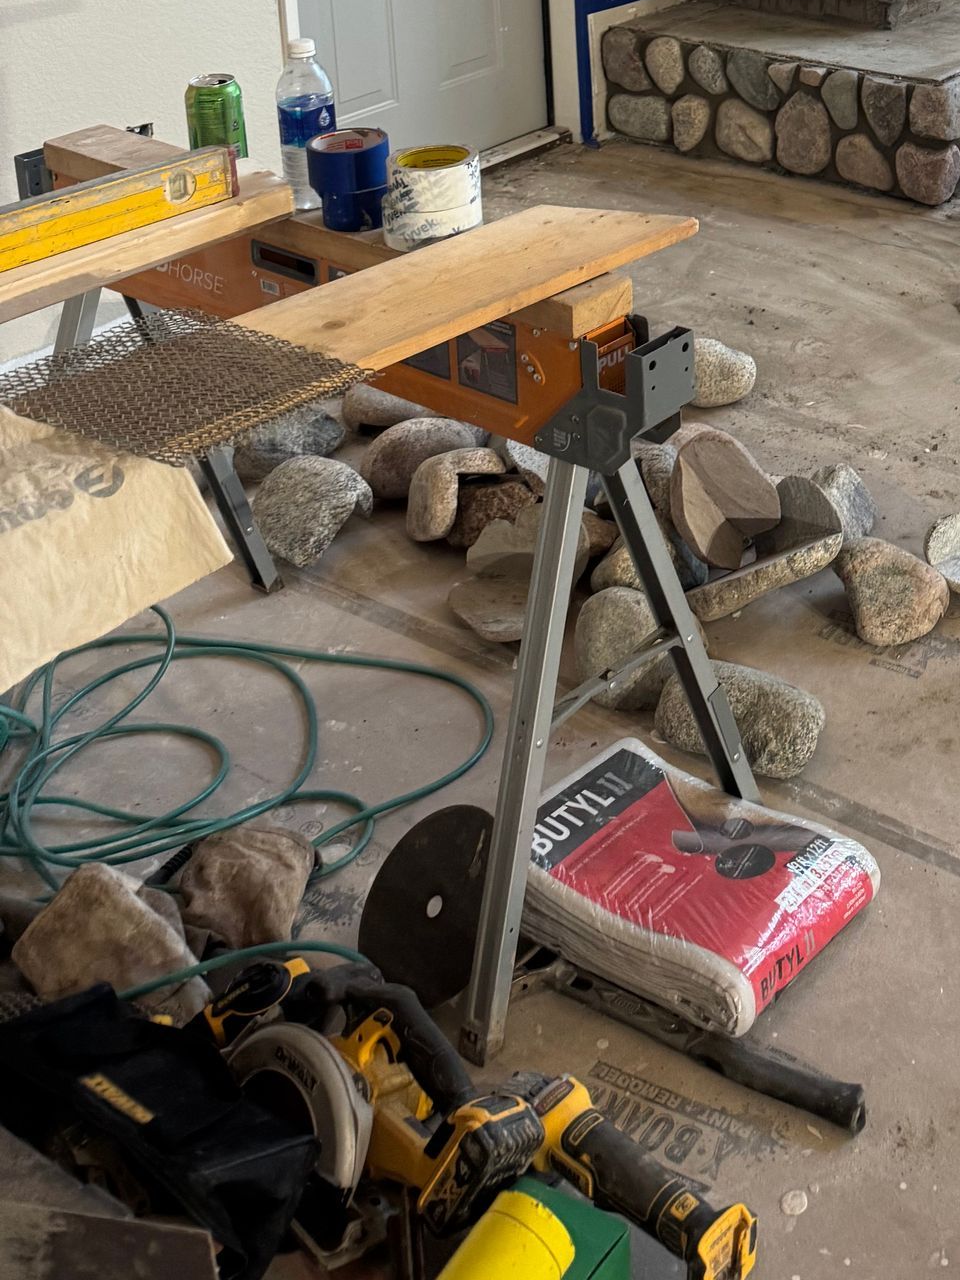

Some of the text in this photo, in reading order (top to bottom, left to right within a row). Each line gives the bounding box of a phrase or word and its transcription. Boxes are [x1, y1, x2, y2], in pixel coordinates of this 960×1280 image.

[400, 217, 436, 243] Tyvek
[532, 789, 616, 856] BUTYL
[761, 944, 804, 1001] BUTYL
[598, 1063, 682, 1108] REMODEL
